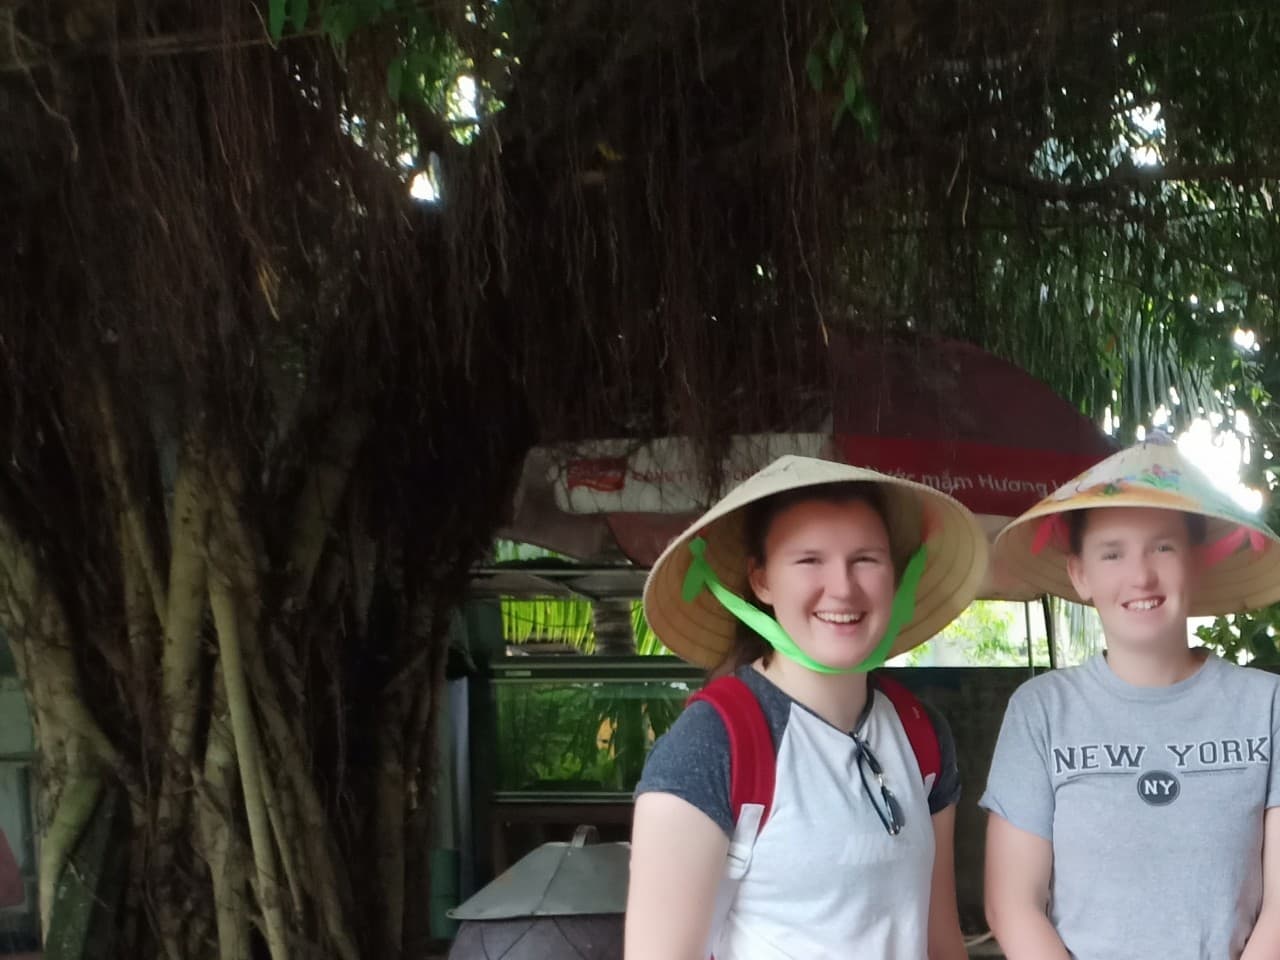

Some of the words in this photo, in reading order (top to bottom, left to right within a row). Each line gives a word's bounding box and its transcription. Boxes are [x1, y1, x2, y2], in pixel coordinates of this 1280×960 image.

[1052, 743, 1147, 775] NEW
[1166, 736, 1270, 768] YORK
[1143, 778, 1176, 796] NY
